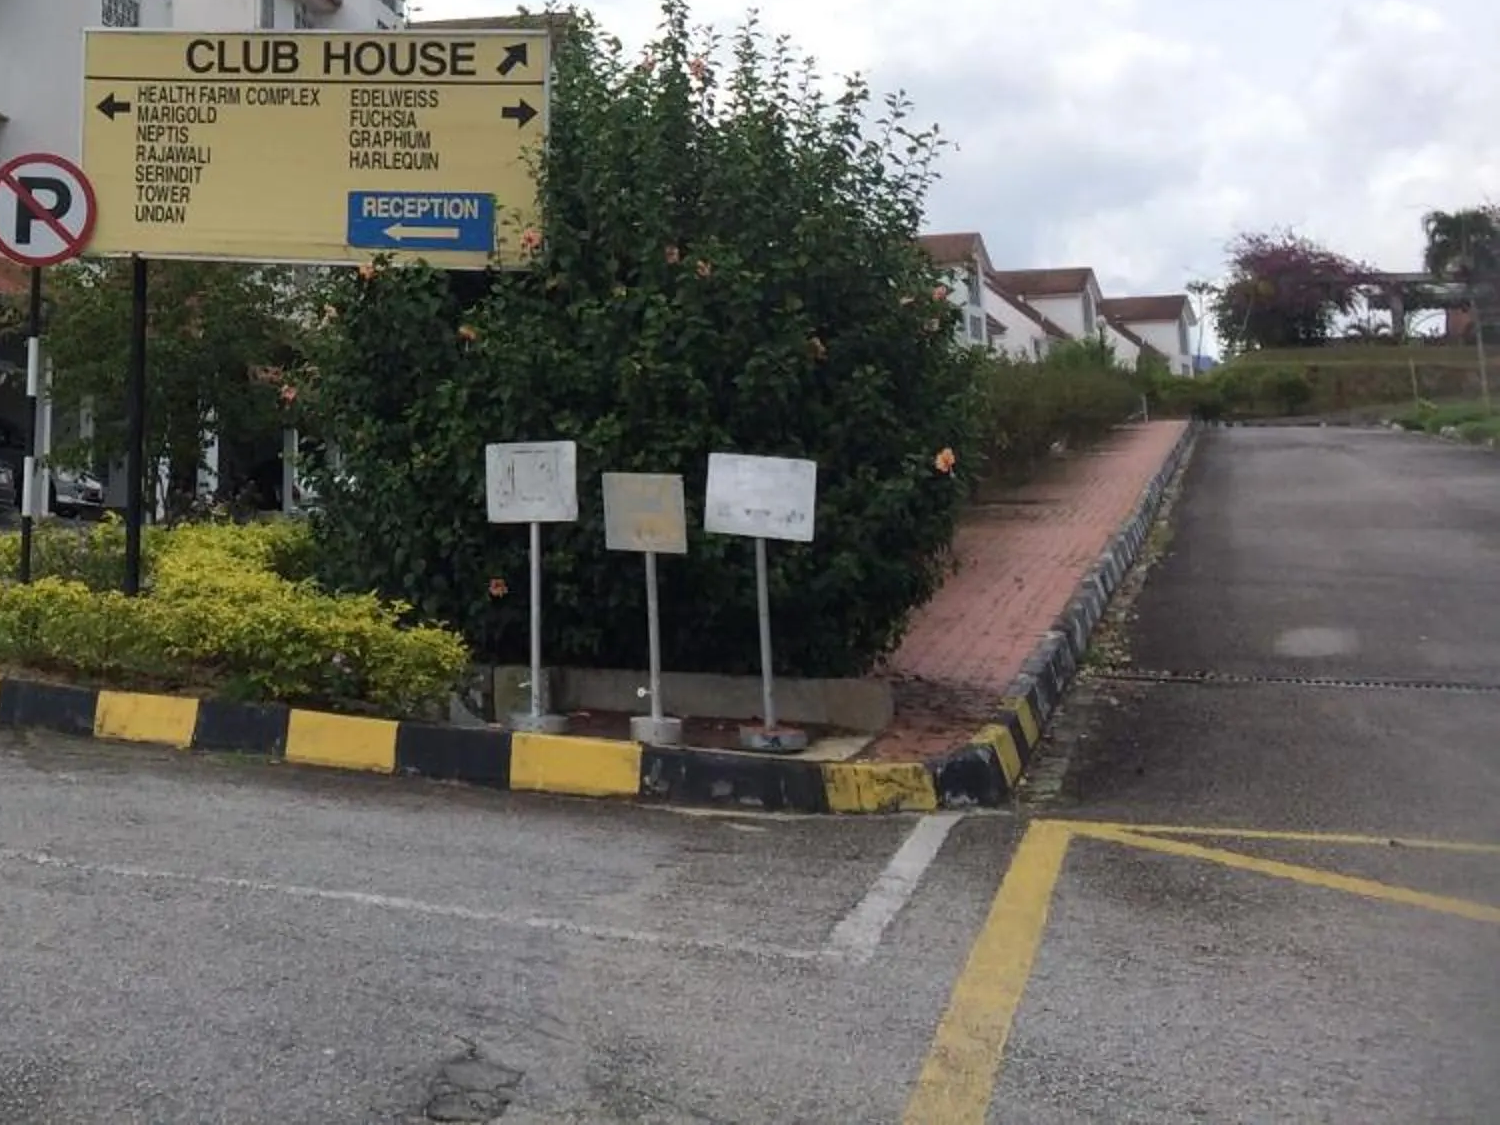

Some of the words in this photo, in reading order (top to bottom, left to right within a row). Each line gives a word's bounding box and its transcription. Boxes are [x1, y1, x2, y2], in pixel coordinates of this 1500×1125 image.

[186, 39, 299, 74] CLUB
[324, 42, 475, 76] HOUSE
[138, 88, 196, 104] HEALTH
[199, 88, 241, 105] FARM
[246, 89, 320, 106] COMPLEX
[350, 90, 438, 108] EDELWEISS
[137, 107, 217, 124] MARIGOLD
[350, 111, 417, 129] FUCHSIA
[136, 126, 188, 143] NEPTIS
[349, 131, 430, 149] GRAPHIUM
[136, 146, 211, 164] RAJAWALI
[349, 152, 439, 170] HARLEQUIN
[135, 166, 203, 184] SERINDIT
[136, 186, 190, 203] TOWER
[15, 176, 72, 244] P
[135, 206, 186, 223] UNDAN
[363, 198, 479, 219] RECEPTION
